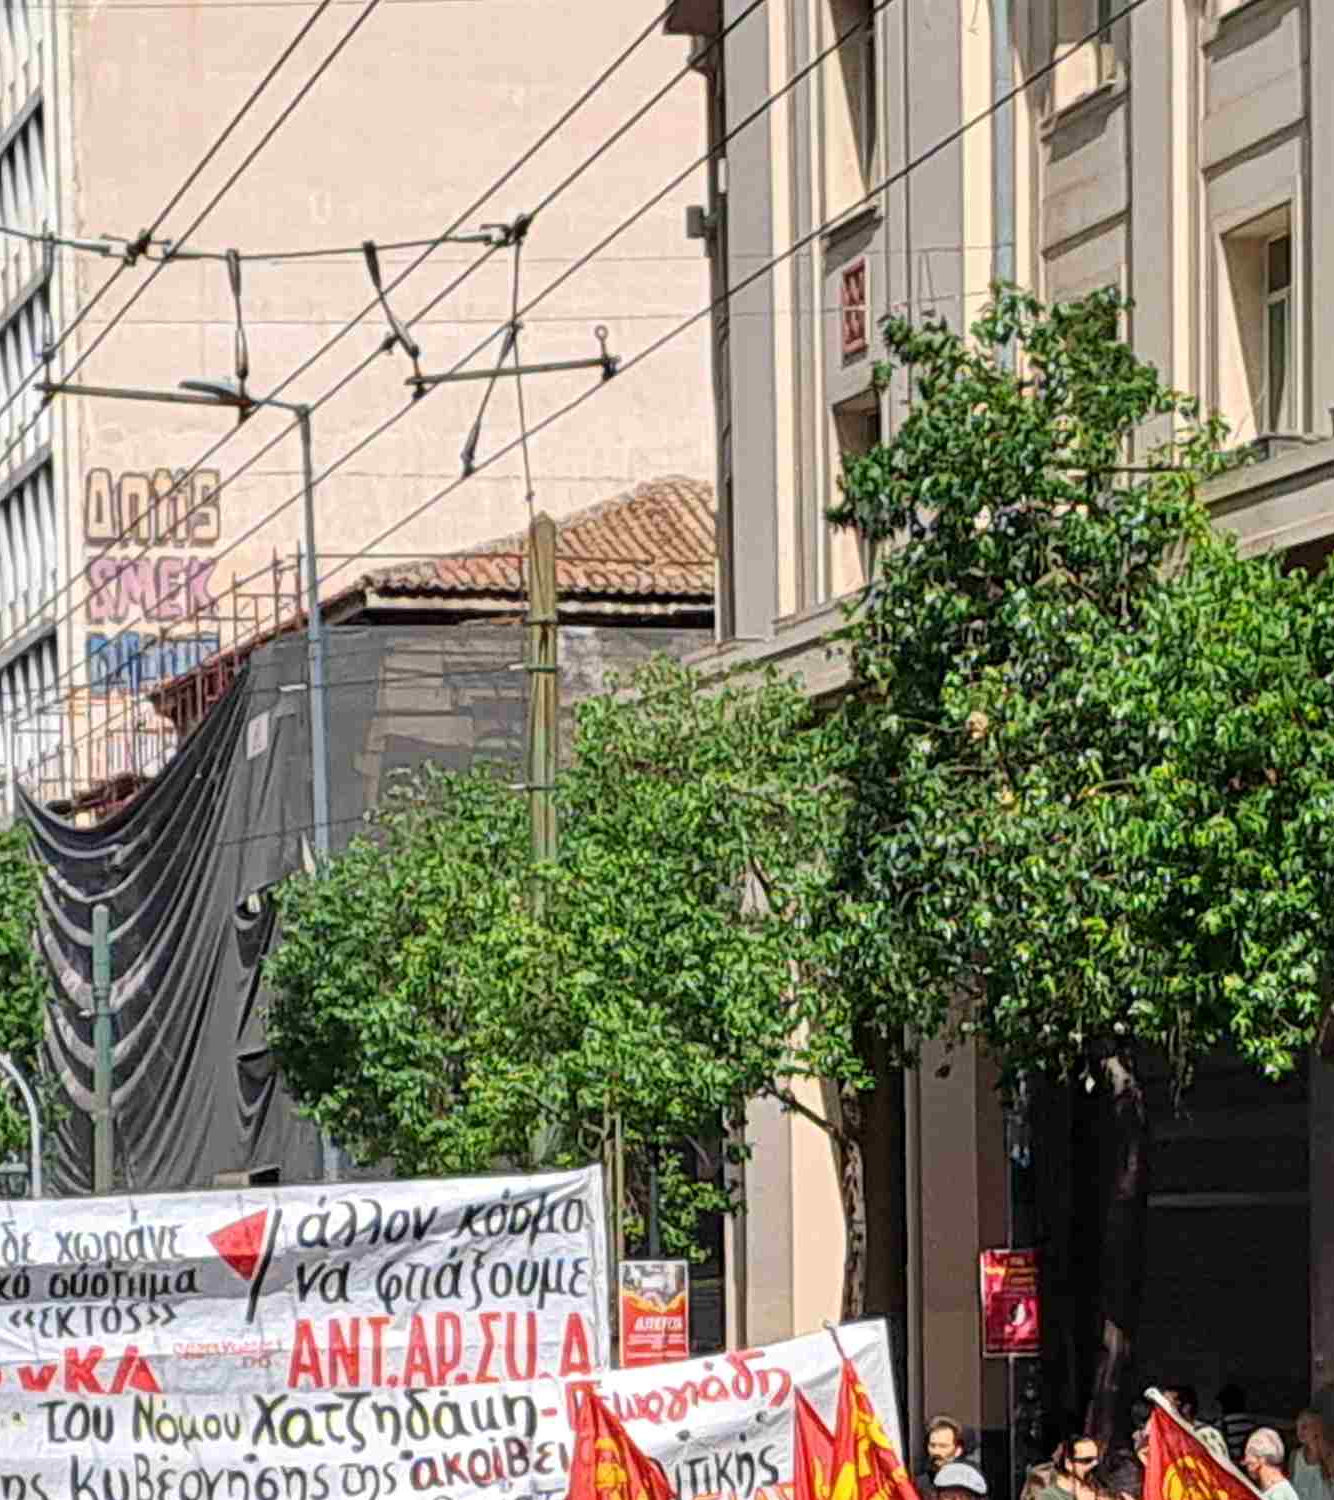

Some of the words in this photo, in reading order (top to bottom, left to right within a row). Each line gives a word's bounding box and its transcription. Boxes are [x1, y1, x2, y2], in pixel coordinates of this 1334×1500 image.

[56, 1212, 185, 1266] χωράνε
[297, 1196, 439, 1248] άλλον
[296, 1261, 351, 1304] να
[375, 1247, 589, 1314] φτιάξουμε
[40, 1400, 114, 1444] του
